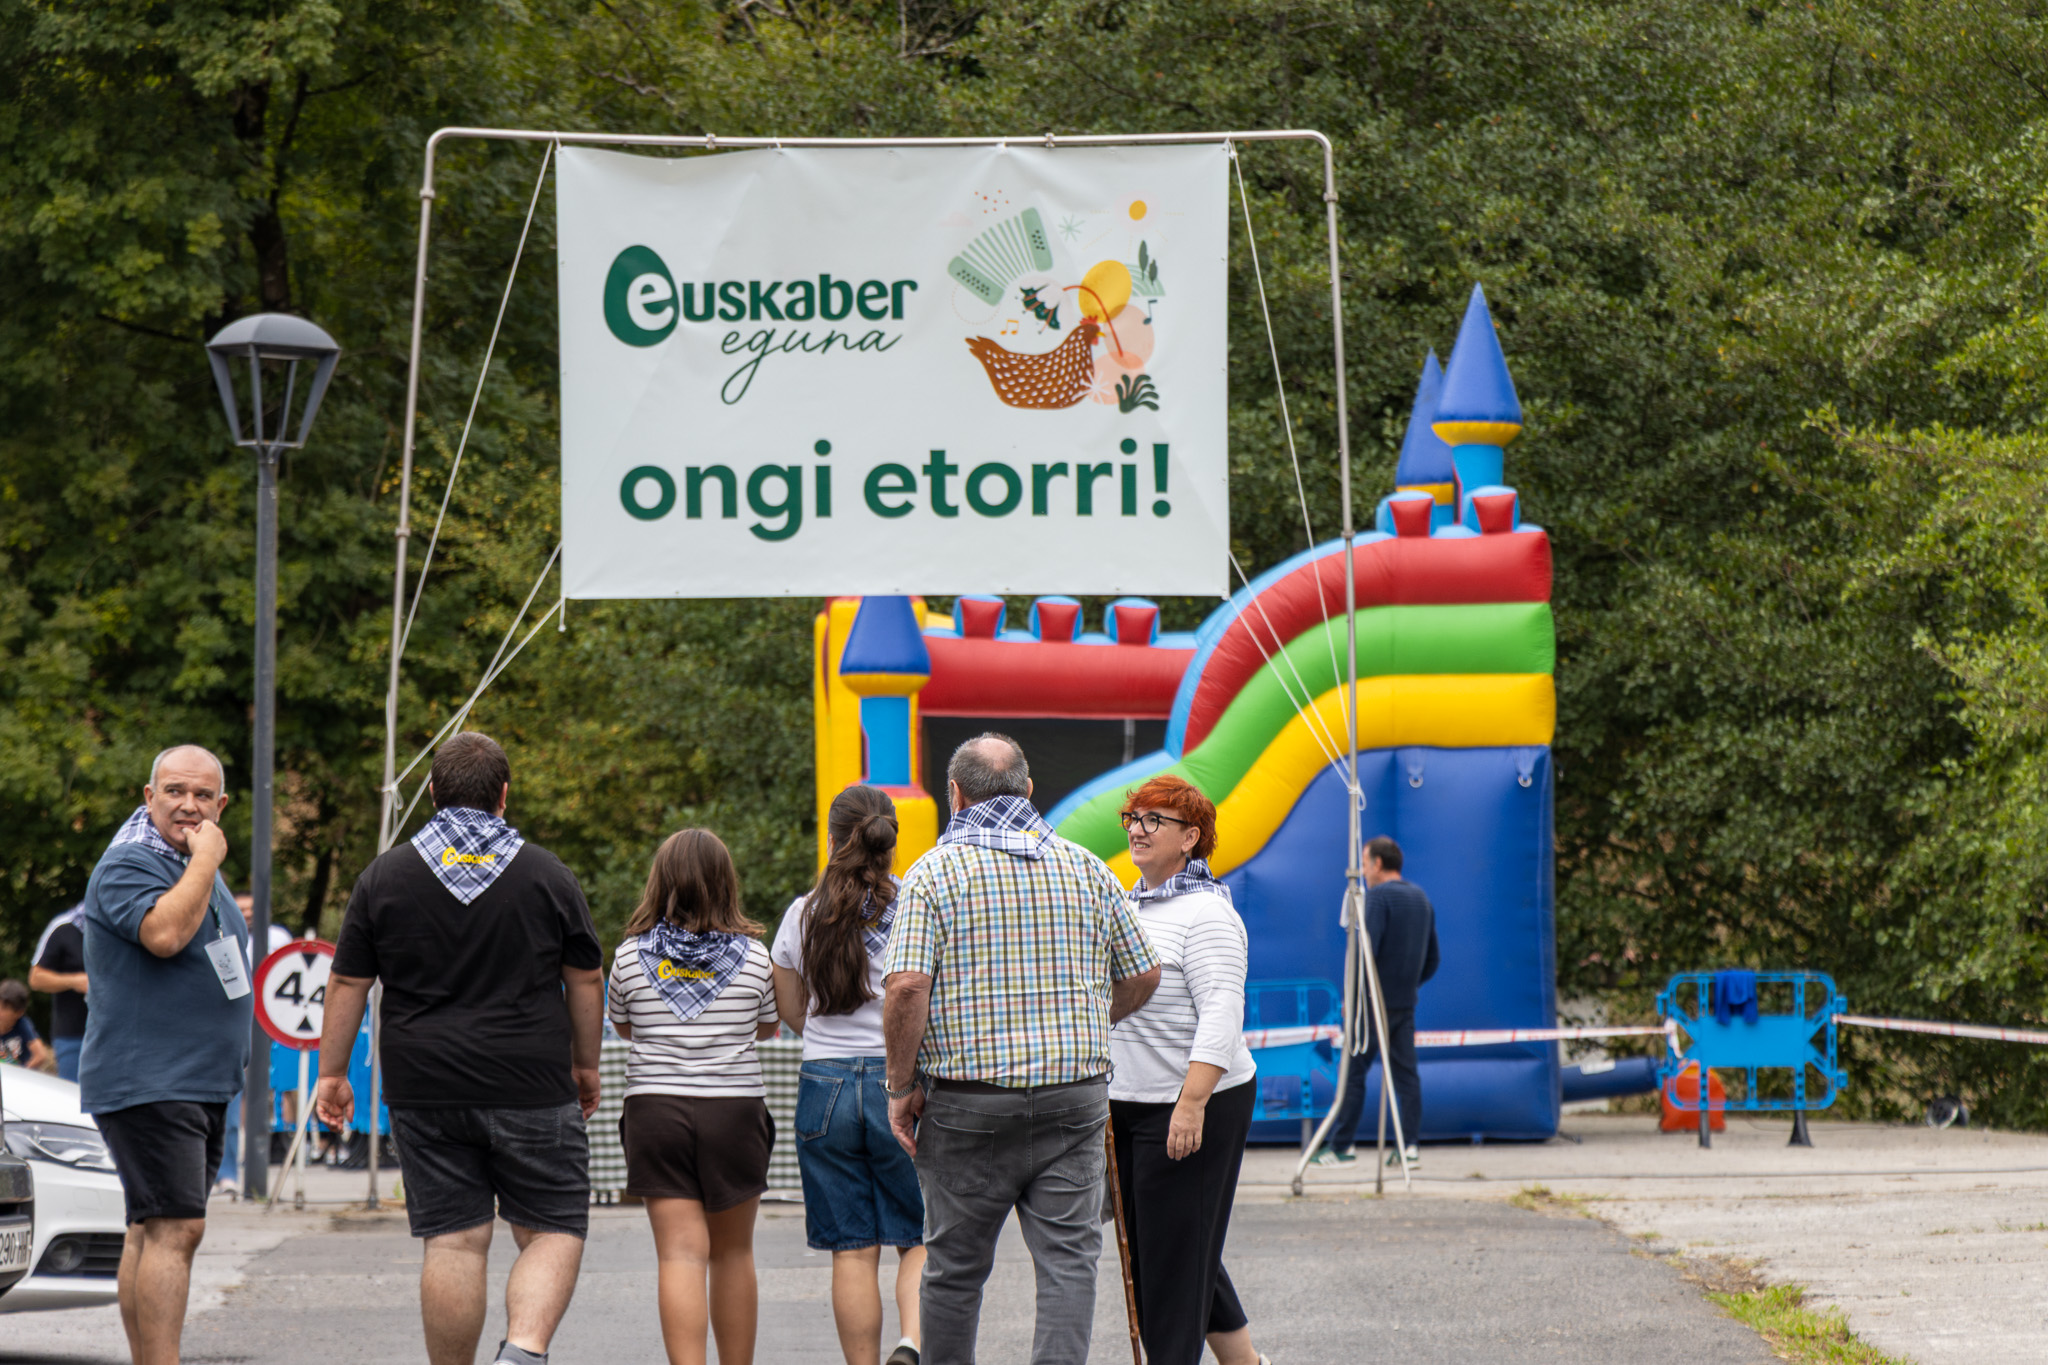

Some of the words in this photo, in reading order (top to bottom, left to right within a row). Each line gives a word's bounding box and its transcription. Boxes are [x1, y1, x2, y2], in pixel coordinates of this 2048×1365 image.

[721, 328, 902, 405] eguna
[619, 439, 832, 542] ongi
[863, 437, 1172, 519] etorri!
